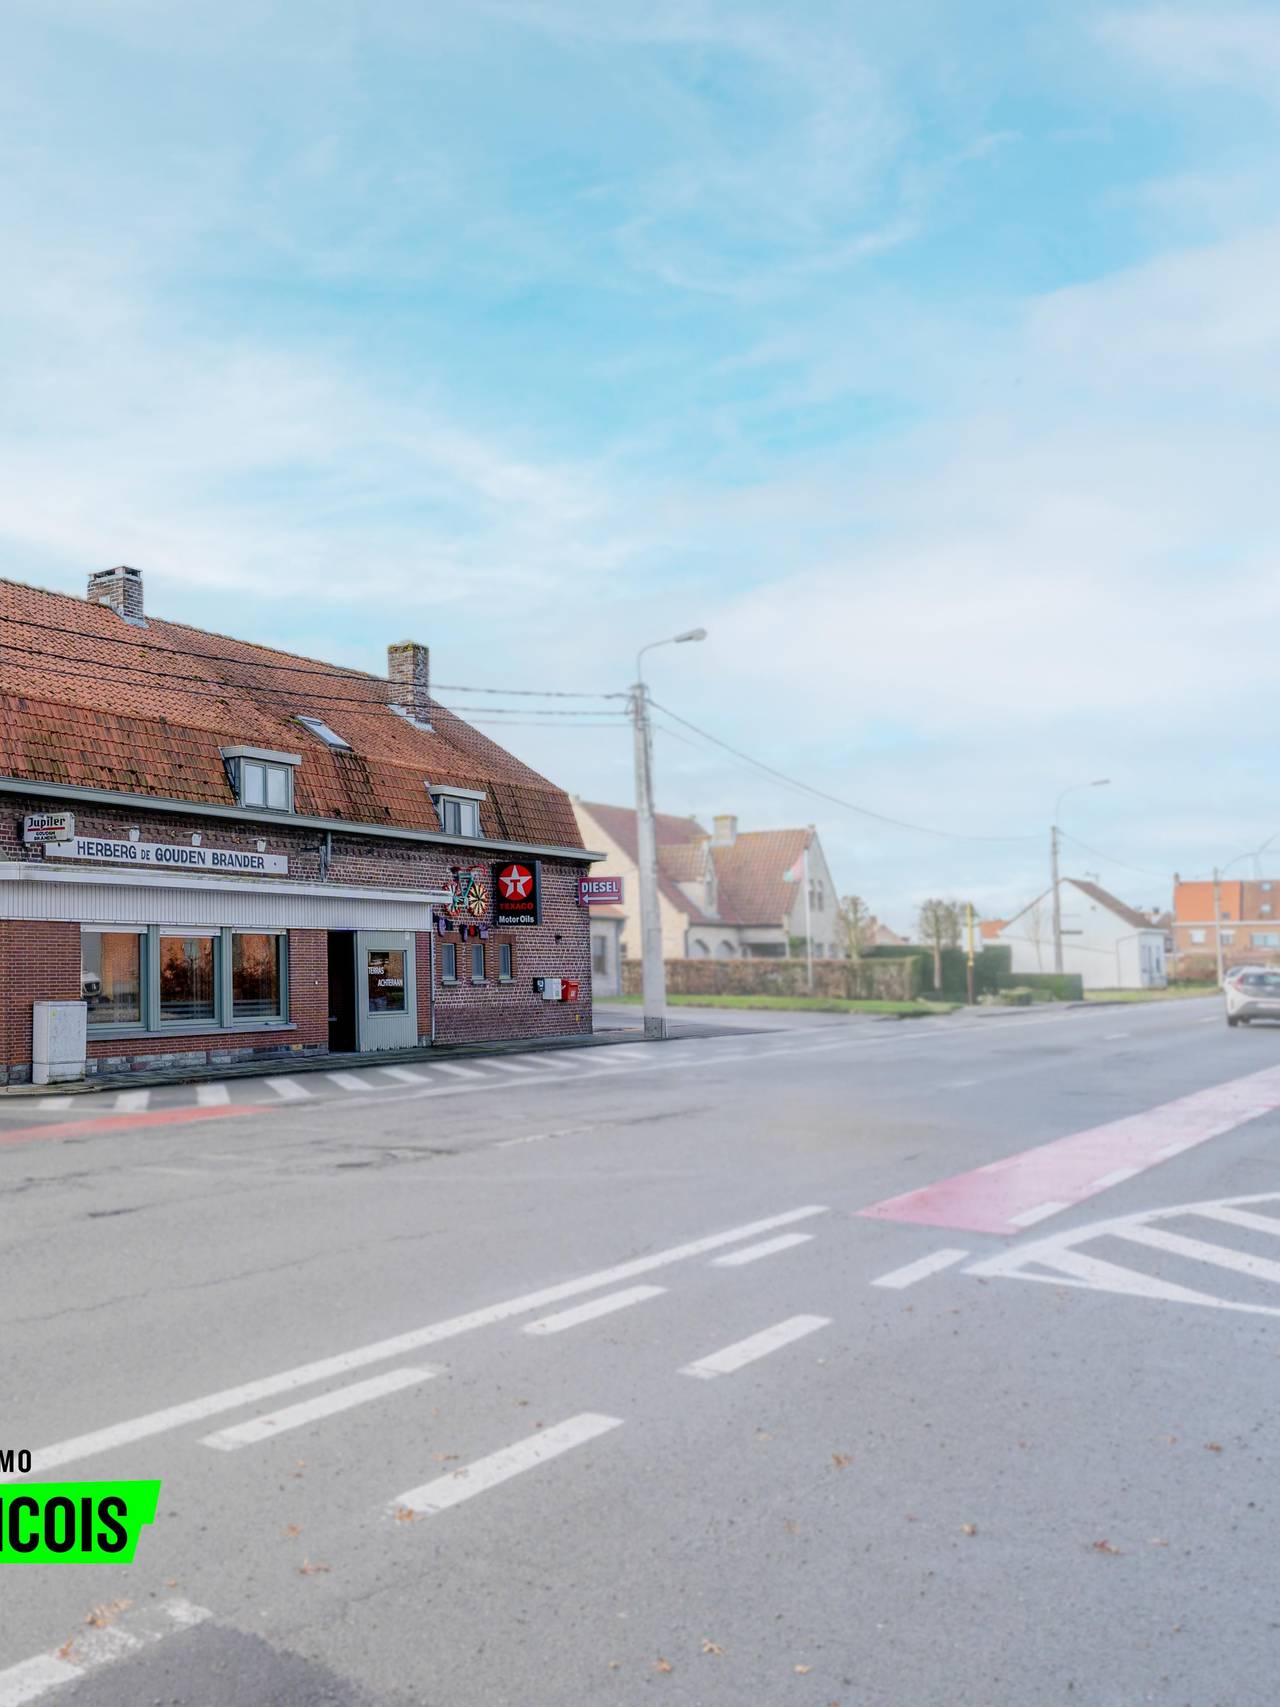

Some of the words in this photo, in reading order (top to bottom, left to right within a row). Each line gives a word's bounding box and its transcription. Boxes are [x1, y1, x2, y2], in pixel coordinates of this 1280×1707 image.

[28, 816, 65, 828] Jupiler
[77, 840, 136, 860] HERBERG
[141, 849, 150, 860] DE
[155, 847, 206, 865] GOUDEN
[212, 852, 265, 869] BRANDER
[581, 881, 618, 893] DIESEL
[499, 902, 533, 910] TEXACO
[498, 915, 519, 923] Motor
[520, 915, 535, 923] Oils
[368, 966, 384, 974] TERRAS
